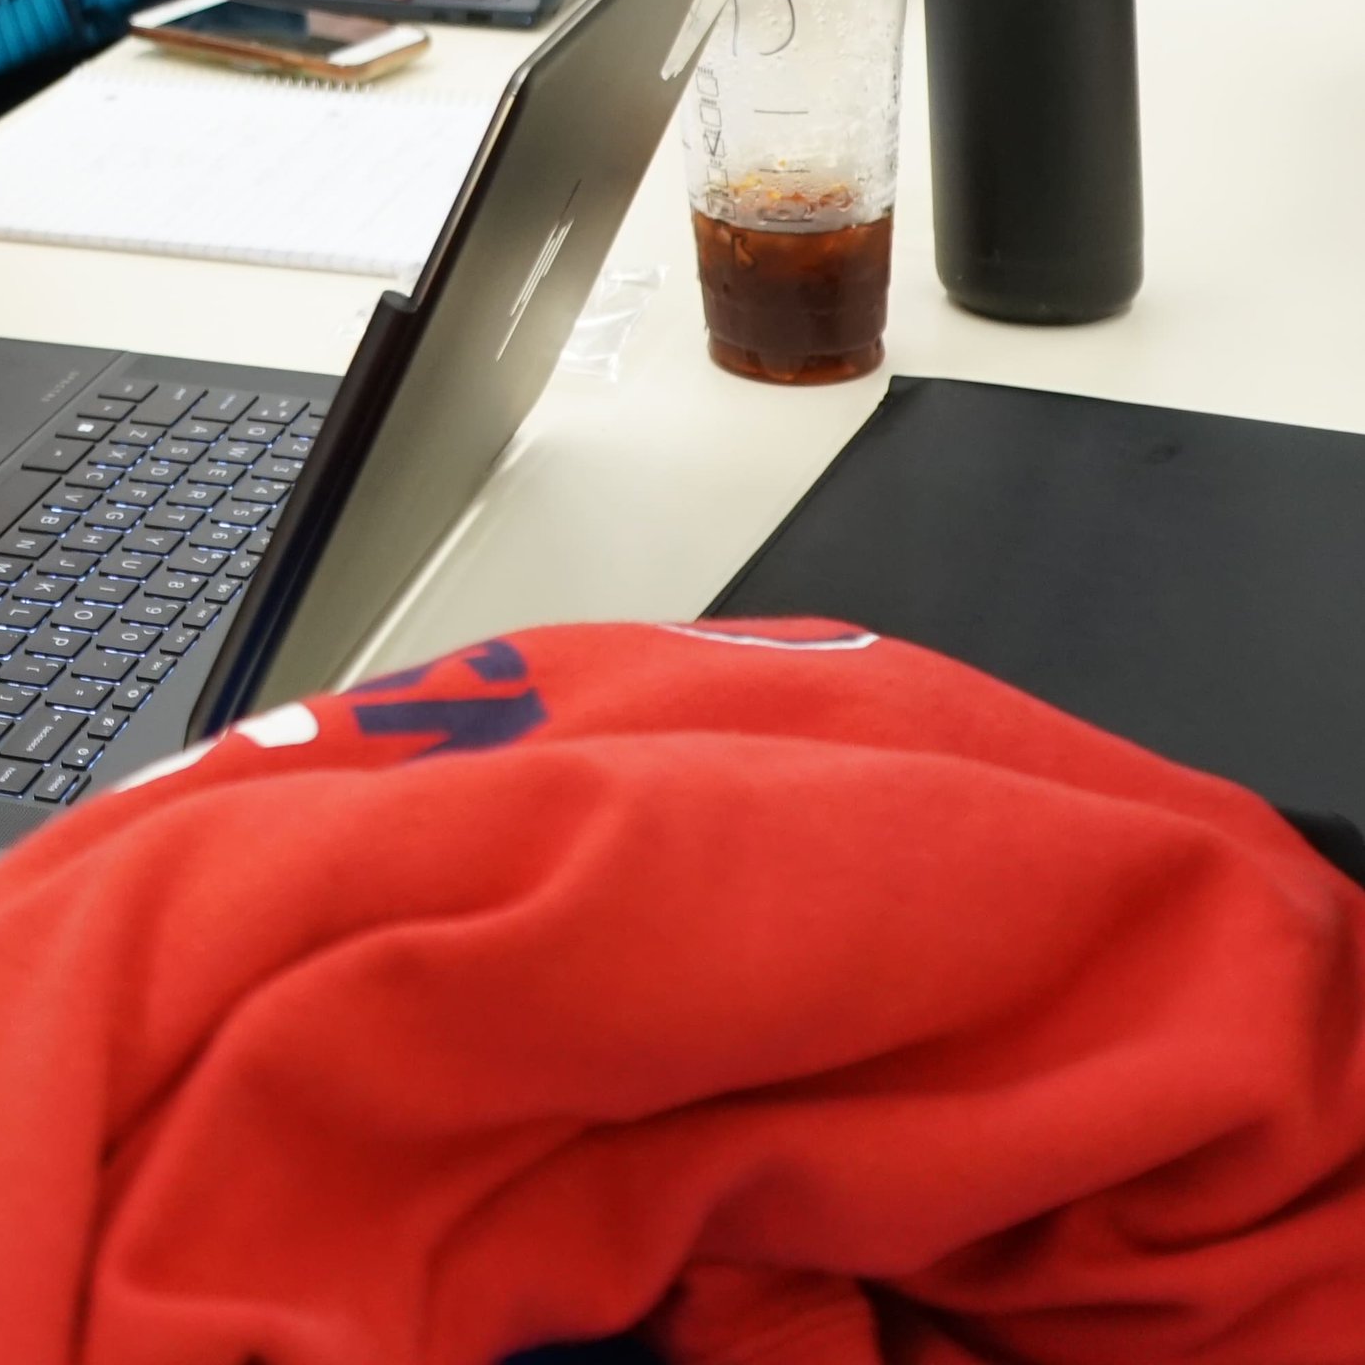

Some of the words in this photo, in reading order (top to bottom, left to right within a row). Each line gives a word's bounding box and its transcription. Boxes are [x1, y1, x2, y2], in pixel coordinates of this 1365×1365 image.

[130, 430, 147, 438] Z
[248, 427, 266, 435] Q
[229, 448, 248, 457] W
[151, 467, 168, 475] D
[208, 469, 227, 477] E
[86, 472, 103, 480] C
[41, 516, 59, 524] B
[83, 535, 101, 543] H
[16, 540, 35, 548] N
[122, 560, 141, 569] U
[35, 583, 54, 592] K
[74, 611, 93, 619] O
[53, 637, 69, 646] P
